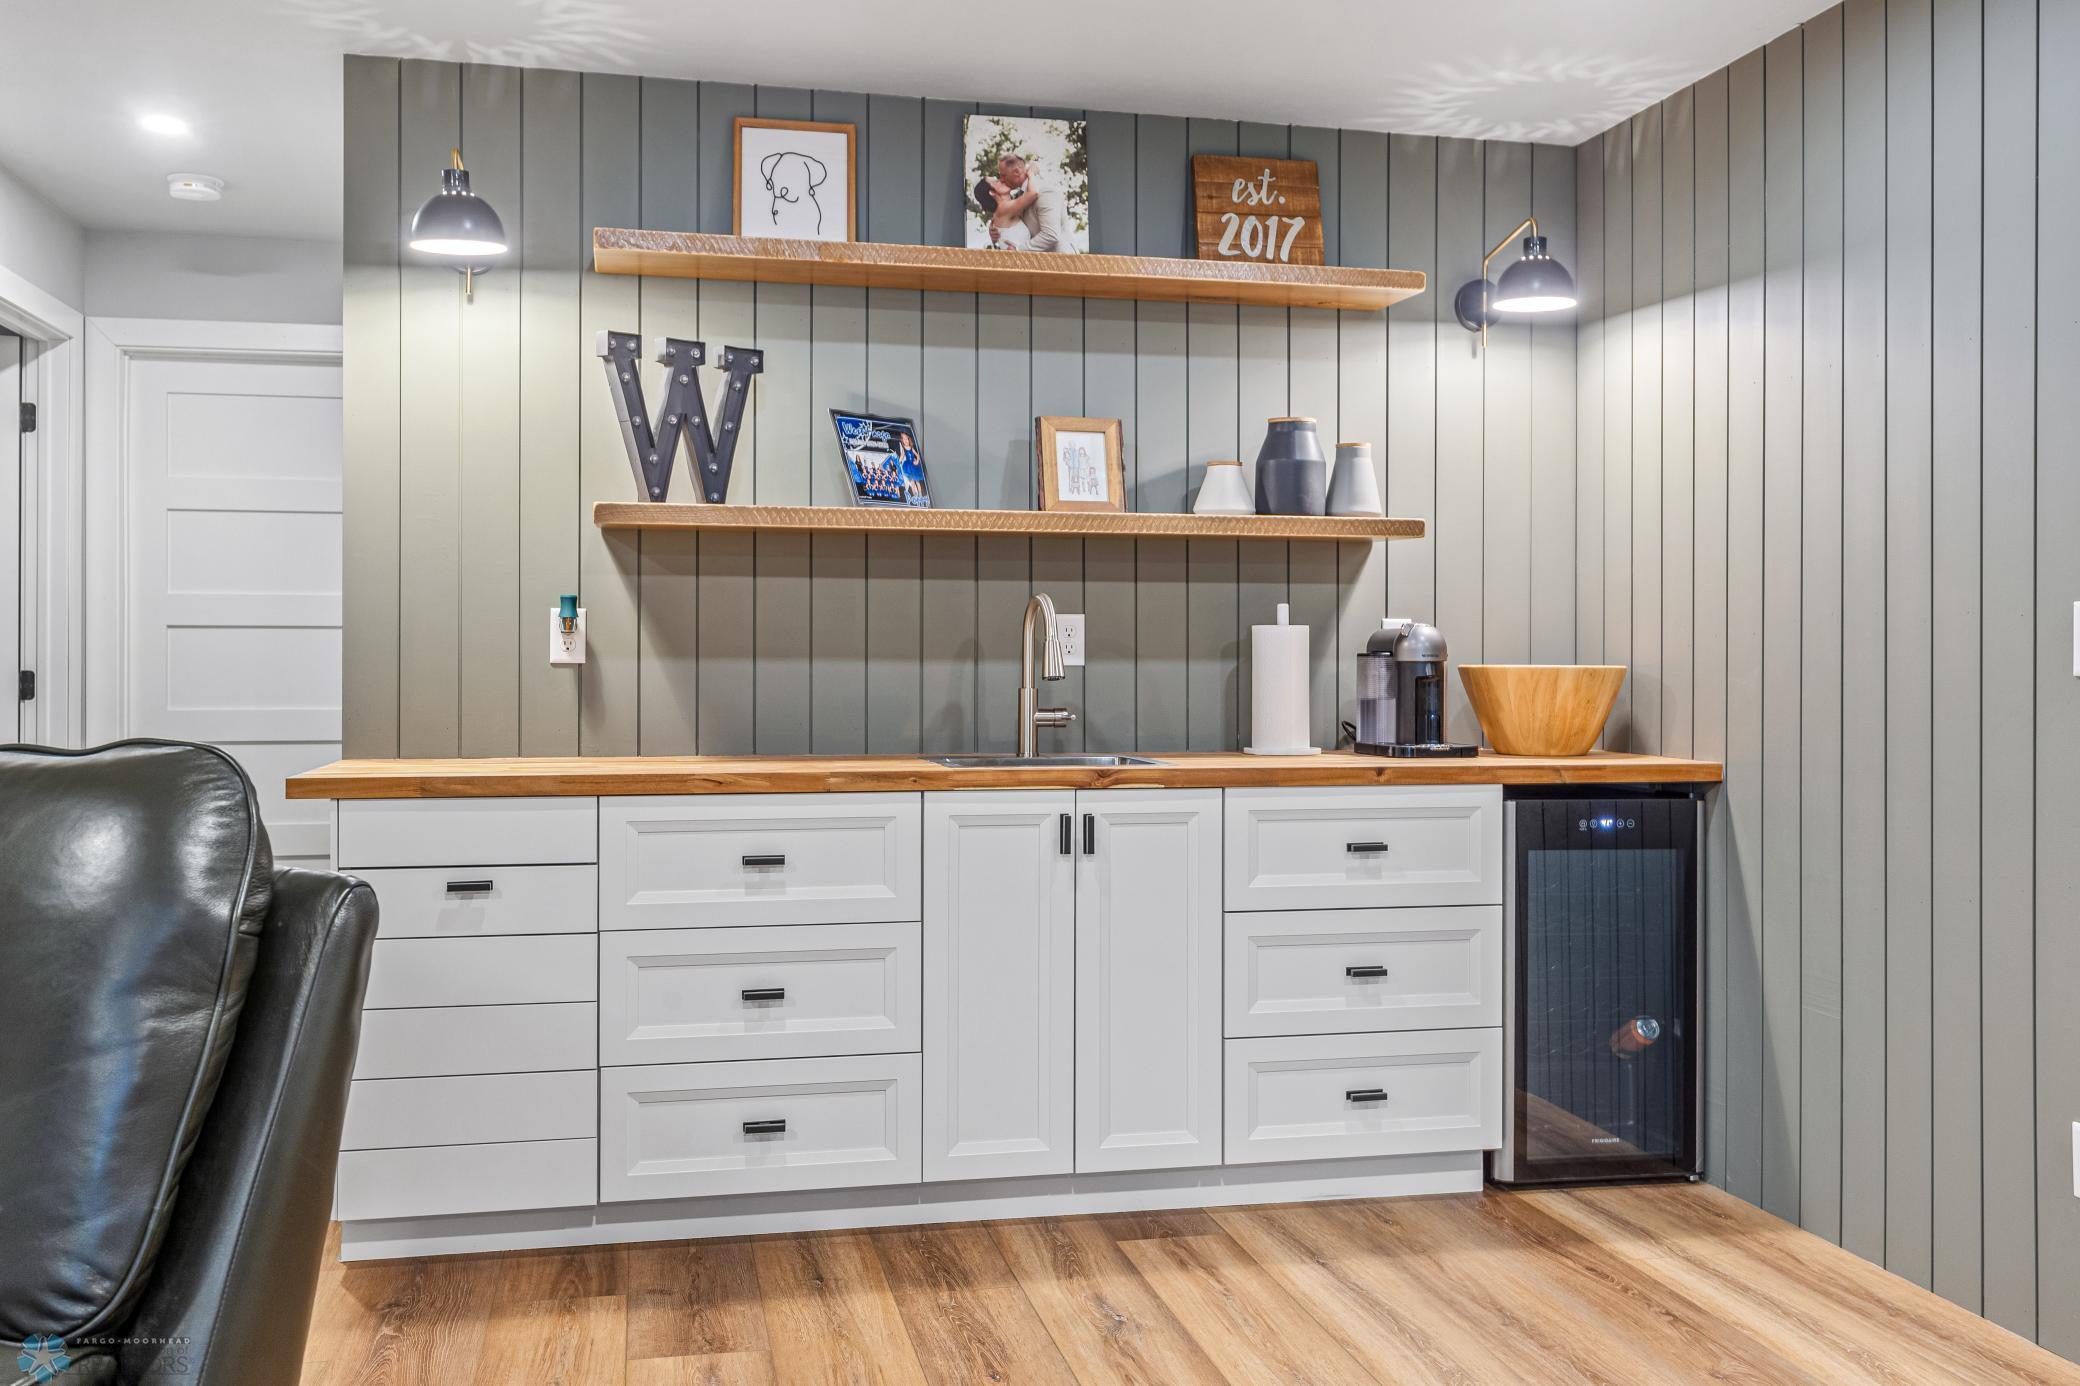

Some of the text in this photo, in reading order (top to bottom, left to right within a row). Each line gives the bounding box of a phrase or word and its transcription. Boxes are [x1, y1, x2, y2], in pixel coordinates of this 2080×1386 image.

[1231, 168, 1286, 206] est.
[1217, 212, 1306, 263] 2017
[596, 330, 764, 505] W
